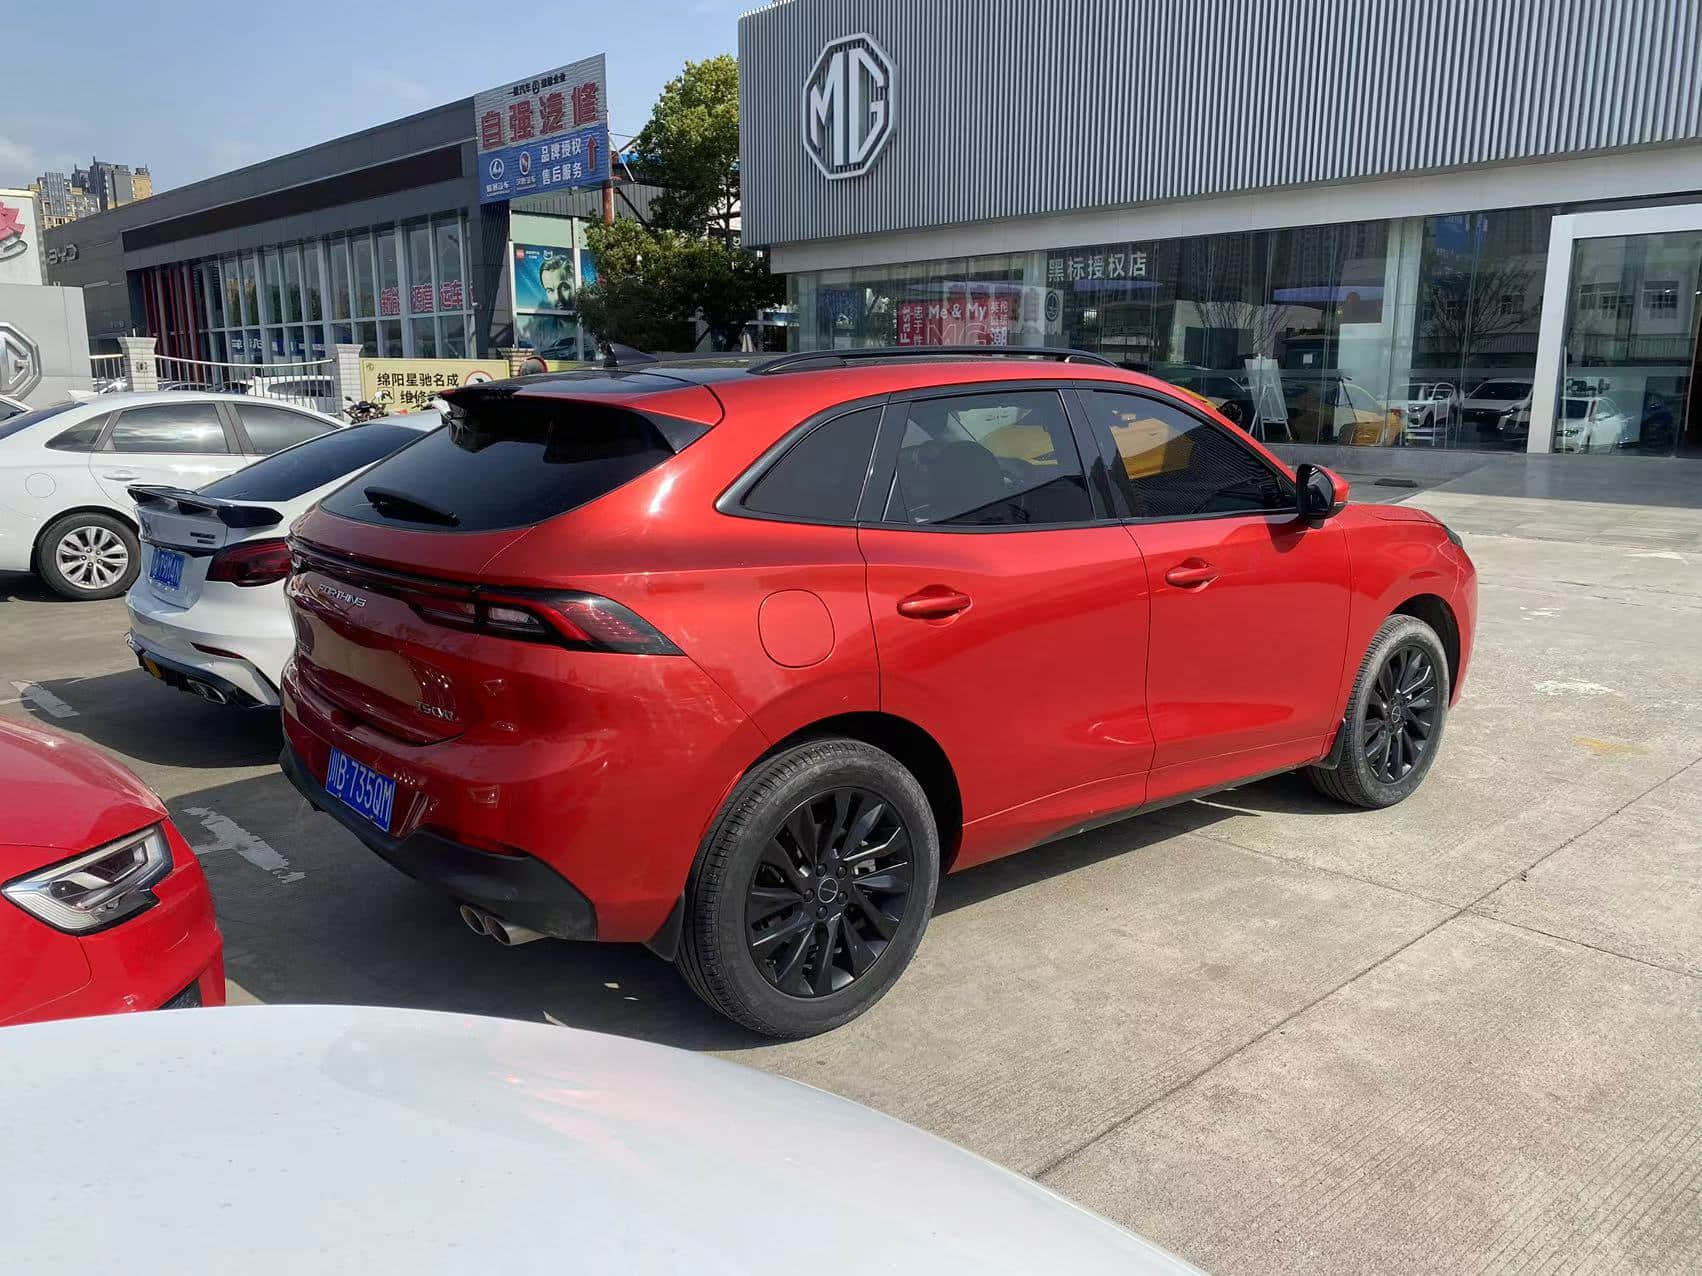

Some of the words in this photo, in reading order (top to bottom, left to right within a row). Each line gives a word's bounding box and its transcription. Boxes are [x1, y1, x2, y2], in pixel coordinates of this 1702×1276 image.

[481, 82, 598, 150] 自强汽修
[810, 47, 885, 166] MG
[541, 138, 582, 162] 品牌授权
[542, 163, 582, 185] 售后服务
[1048, 251, 1147, 281] 黑标授权店
[928, 305, 948, 319] Me
[951, 303, 962, 318] &
[967, 302, 987, 321] My
[377, 372, 460, 387] 绵阳星驰名成
[400, 390, 435, 405] 维修
[320, 583, 367, 607] FORTHING
